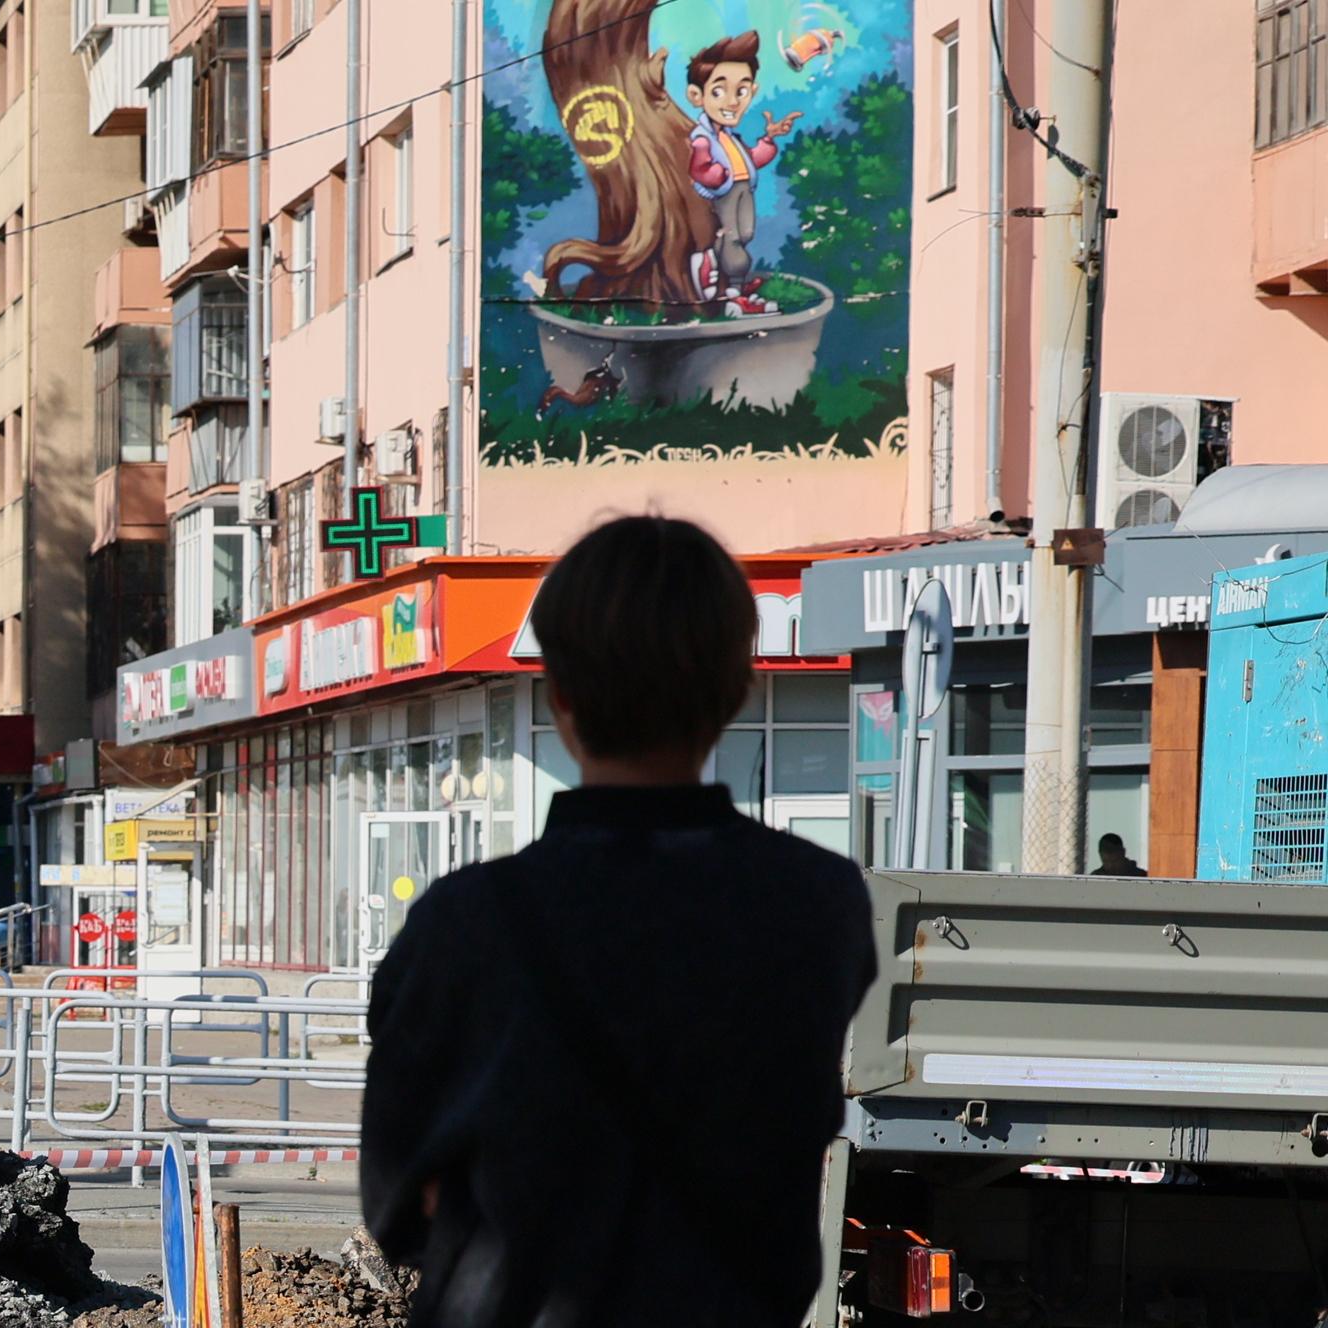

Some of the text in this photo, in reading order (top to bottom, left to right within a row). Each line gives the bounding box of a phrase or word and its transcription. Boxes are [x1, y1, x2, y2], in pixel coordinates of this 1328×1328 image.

[864, 561, 1030, 632] ШАШЛЫ
[1217, 576, 1269, 615] AIRMAN
[1146, 596, 1211, 627] ЦЕН
[115, 803, 181, 814] ВЕТТЕКА
[147, 829, 184, 838] ремонт
